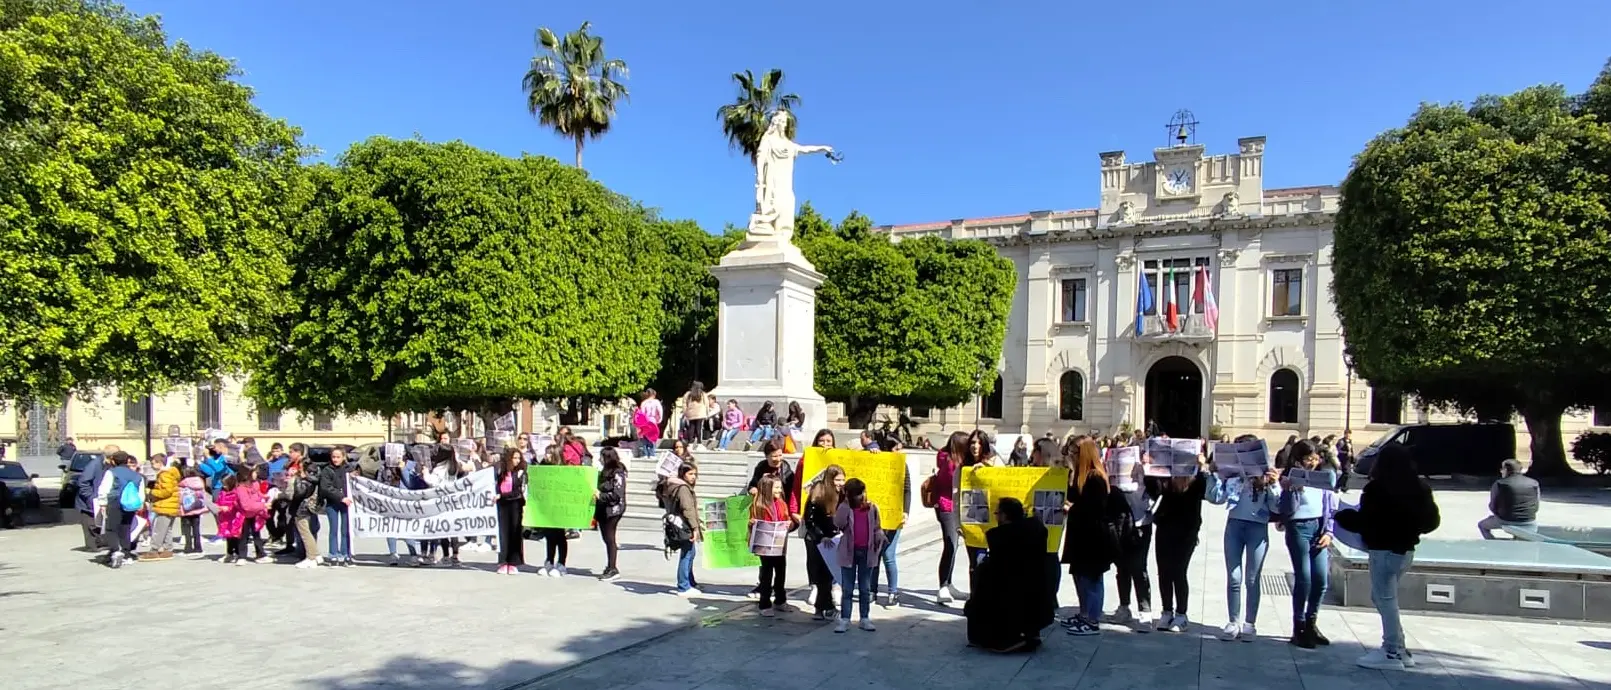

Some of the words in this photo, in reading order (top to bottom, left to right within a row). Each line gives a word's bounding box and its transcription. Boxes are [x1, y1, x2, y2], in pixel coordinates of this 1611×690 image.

[435, 477, 473, 497] ALLA
[435, 491, 494, 512] PRECLUDE
[354, 517, 364, 532] IL
[369, 516, 420, 533] DIRITTO
[423, 518, 450, 535] ALLO
[454, 516, 497, 532] STUDIO
